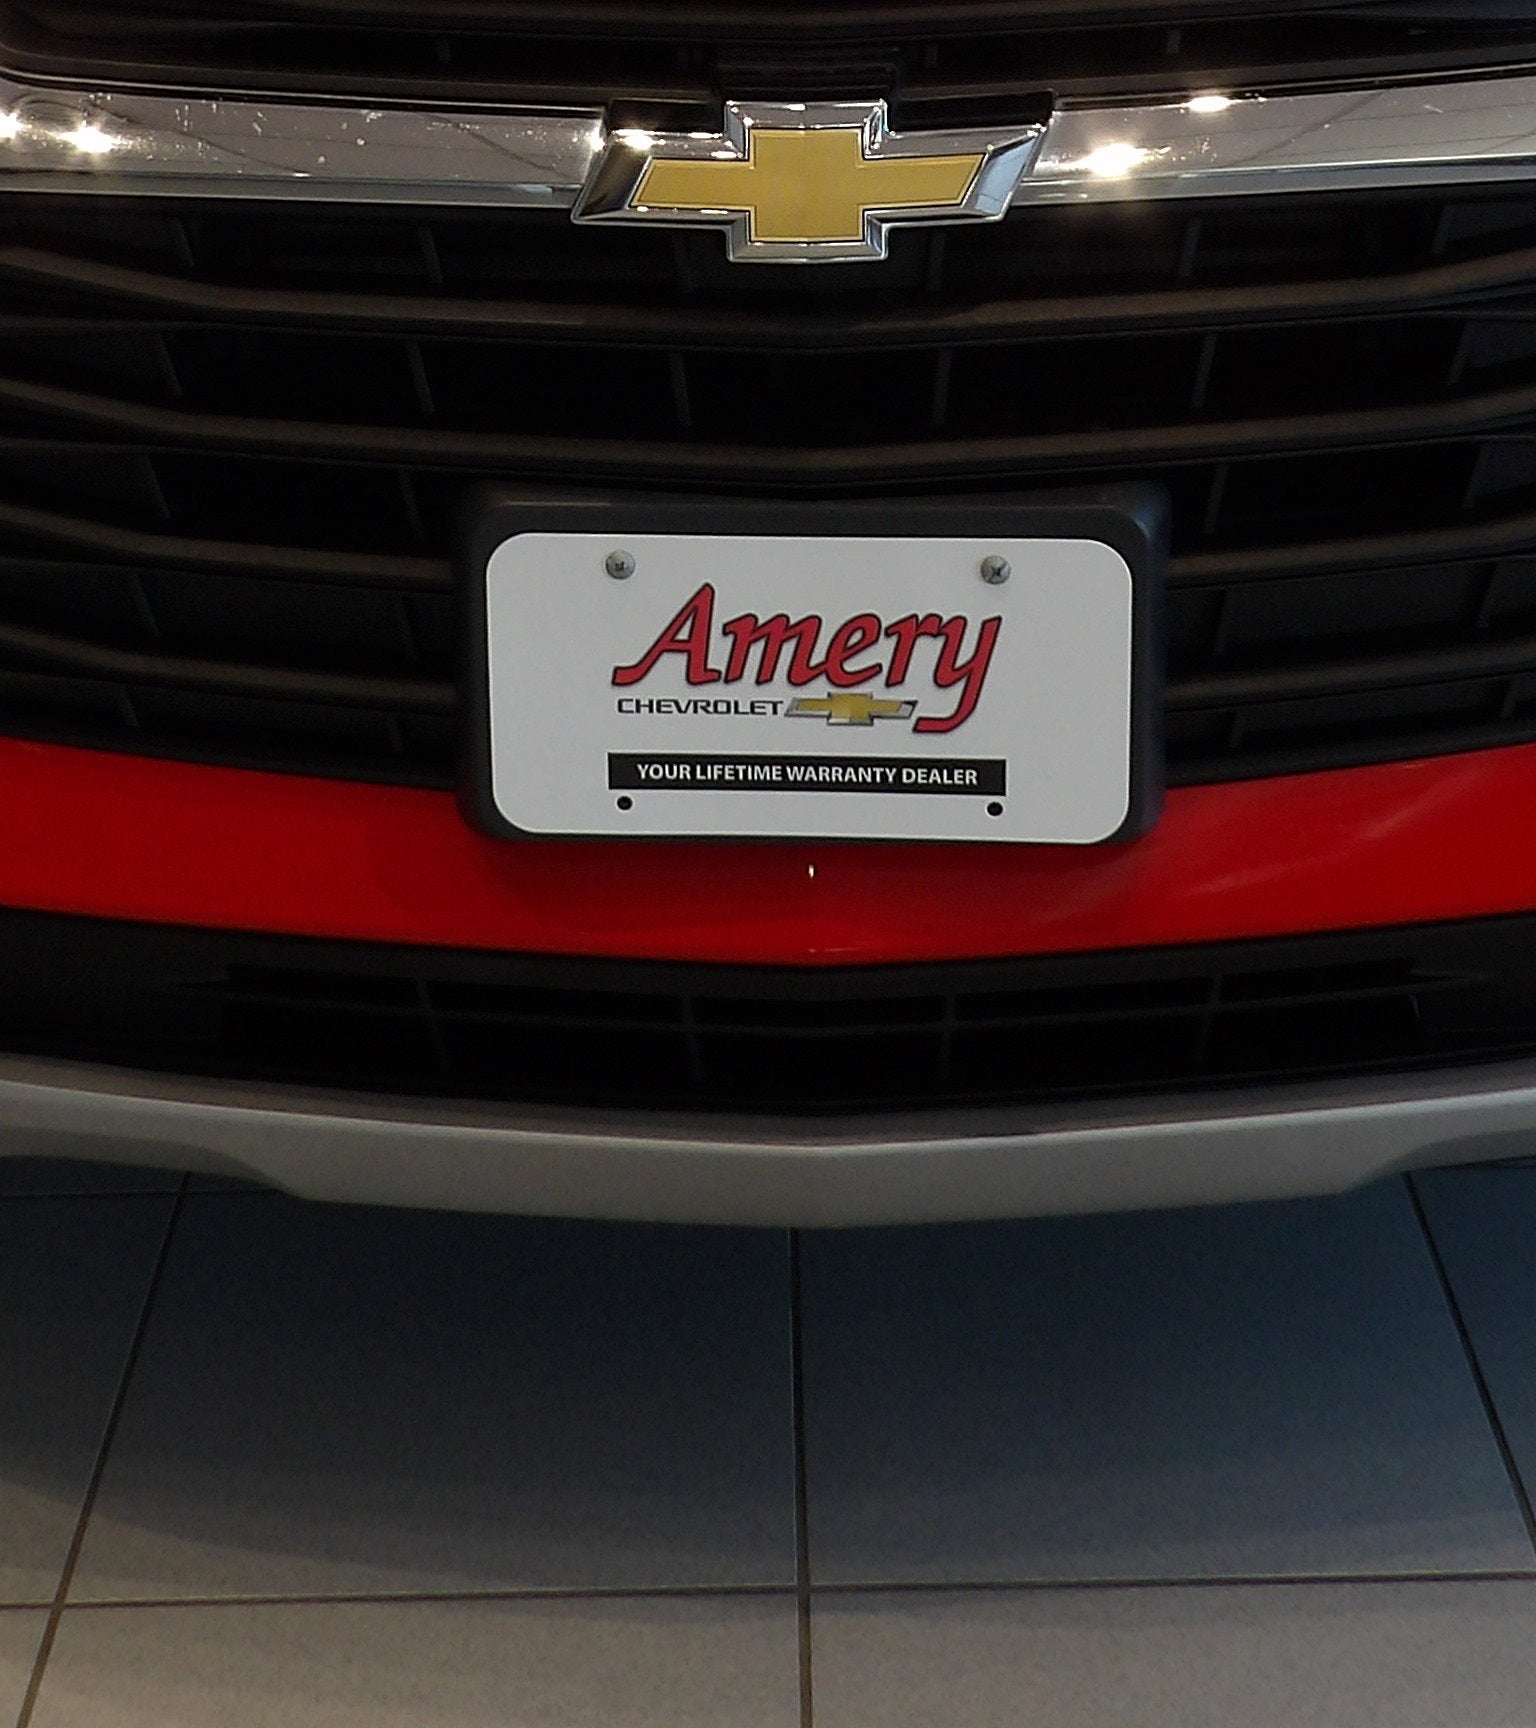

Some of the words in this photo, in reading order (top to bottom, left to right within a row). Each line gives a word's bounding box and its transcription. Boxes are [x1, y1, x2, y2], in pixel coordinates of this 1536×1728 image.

[611, 582, 1002, 734] Amery
[617, 698, 784, 716] CHEVROLET
[637, 763, 692, 780] YOUR
[695, 764, 783, 782] LIFETIME
[786, 765, 898, 784] WARRANTY
[901, 767, 978, 785] DEALER
